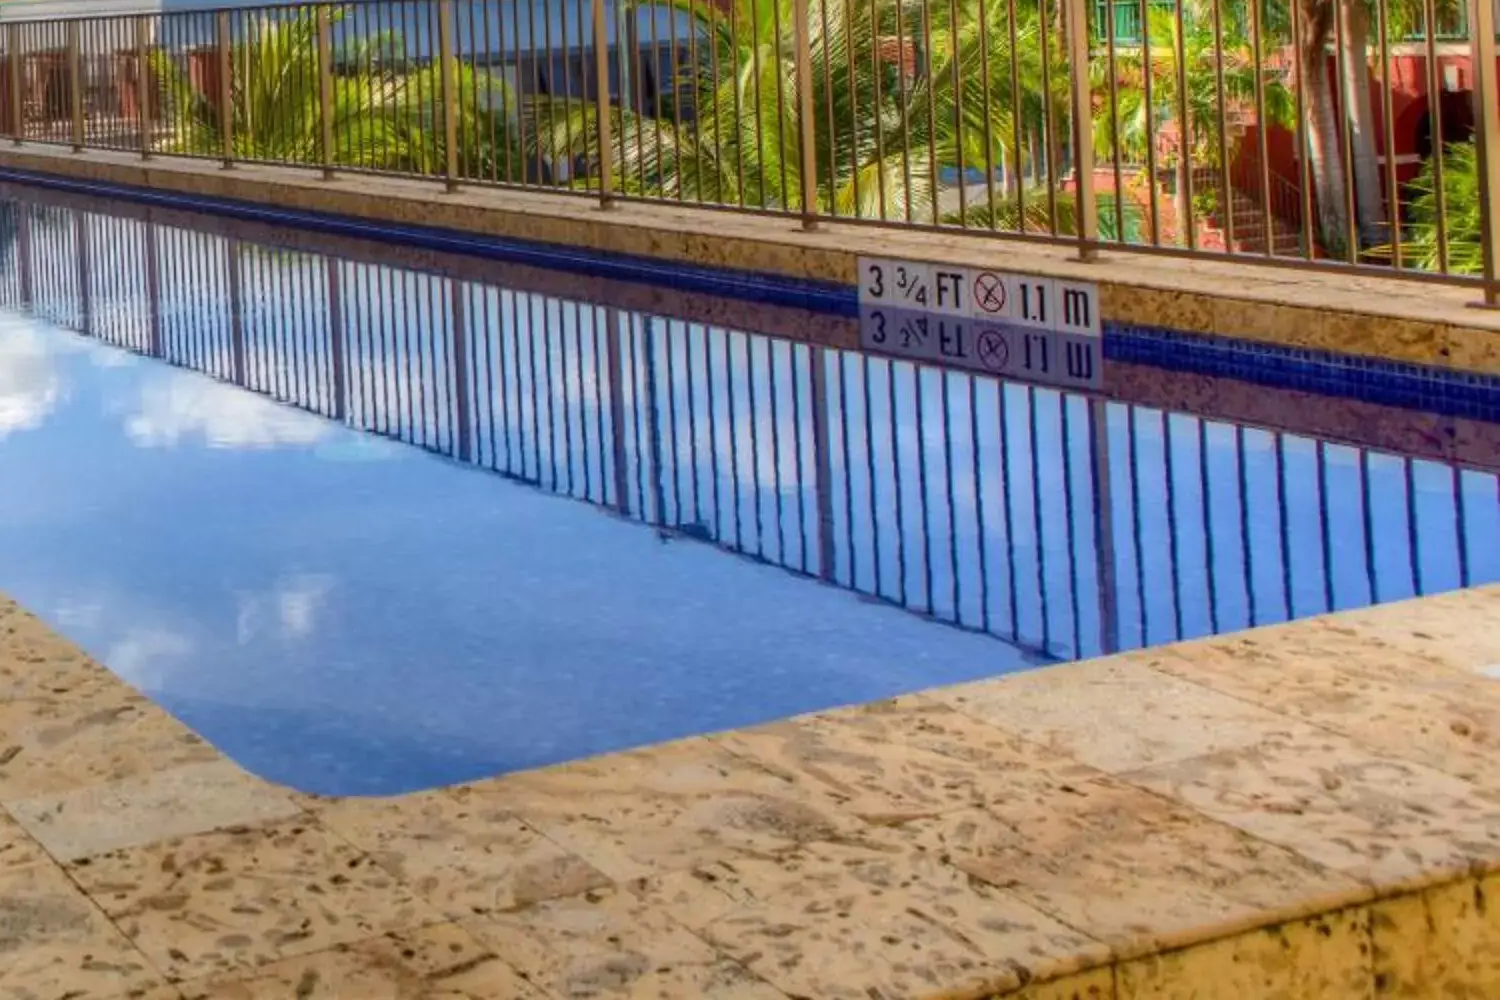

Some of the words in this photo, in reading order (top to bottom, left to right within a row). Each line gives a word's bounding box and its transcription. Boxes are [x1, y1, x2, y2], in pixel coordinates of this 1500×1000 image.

[869, 265, 884, 298] 3
[936, 271, 964, 309] FT
[1020, 283, 1046, 323] 1.1
[1063, 288, 1091, 328] m
